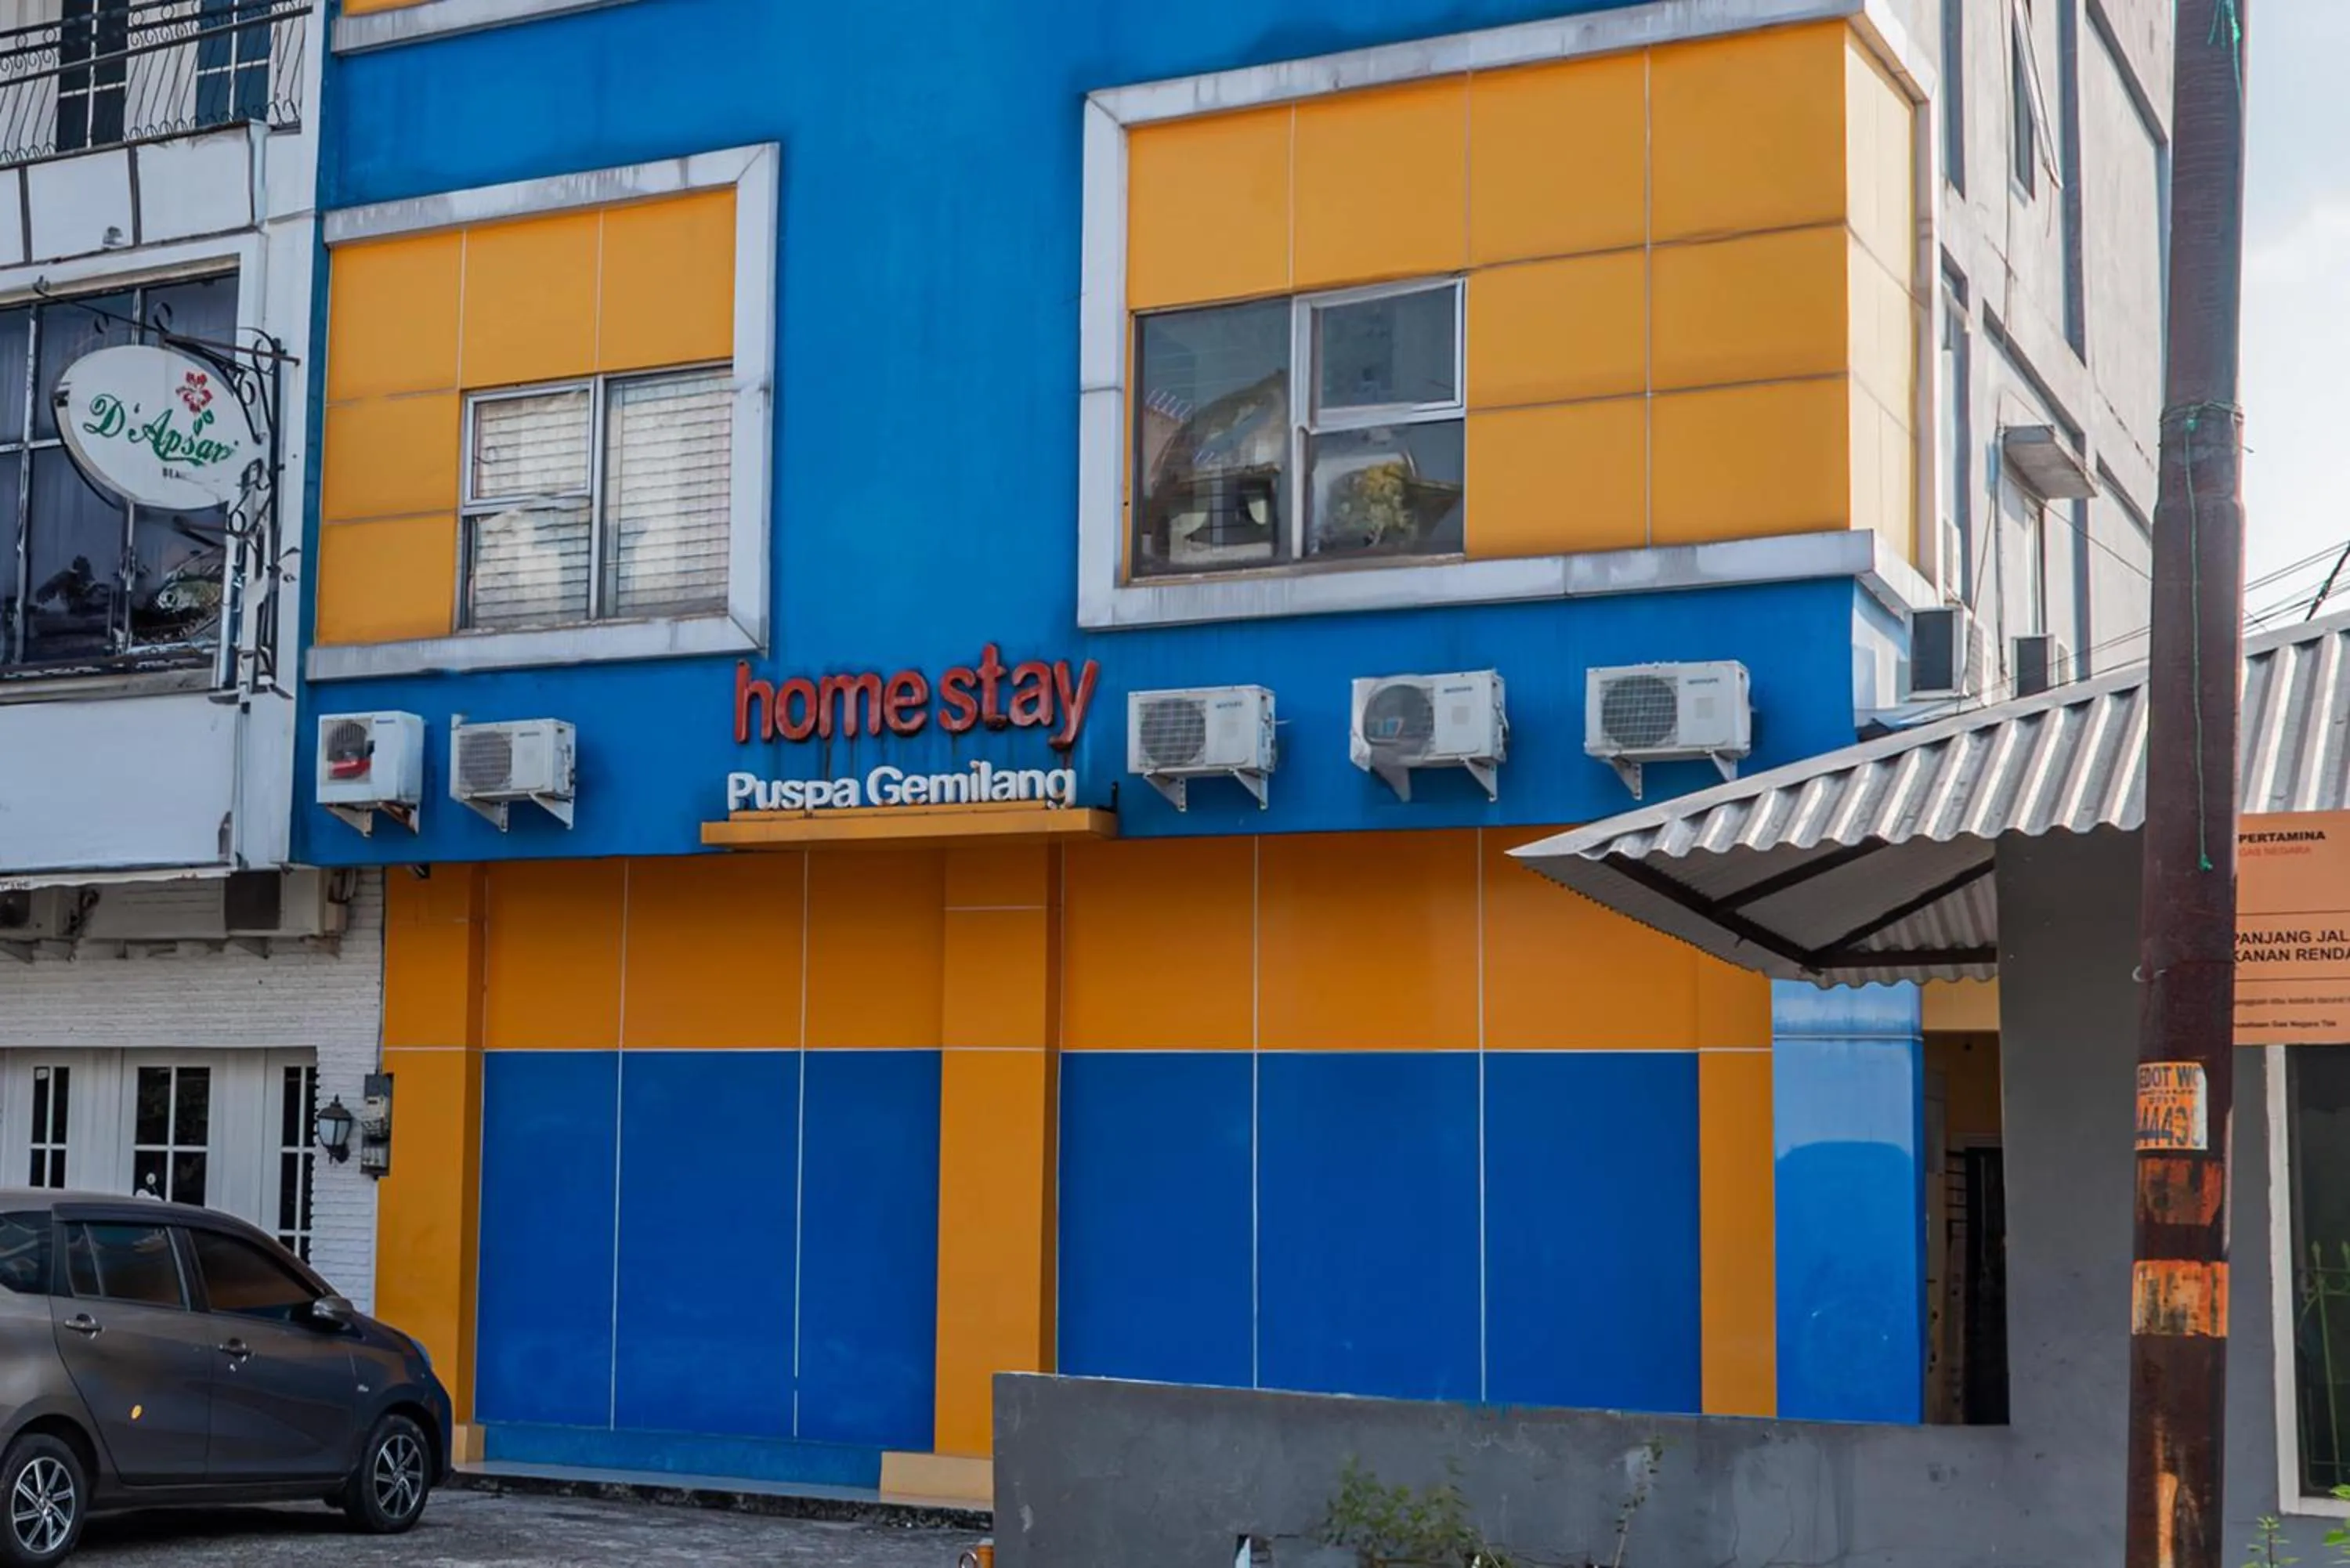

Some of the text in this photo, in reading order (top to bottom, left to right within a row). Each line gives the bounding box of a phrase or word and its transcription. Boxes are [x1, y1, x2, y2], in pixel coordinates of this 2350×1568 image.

[727, 760, 1076, 811] Puspa Gemilang
[2238, 831, 2326, 844] PERTAMINA
